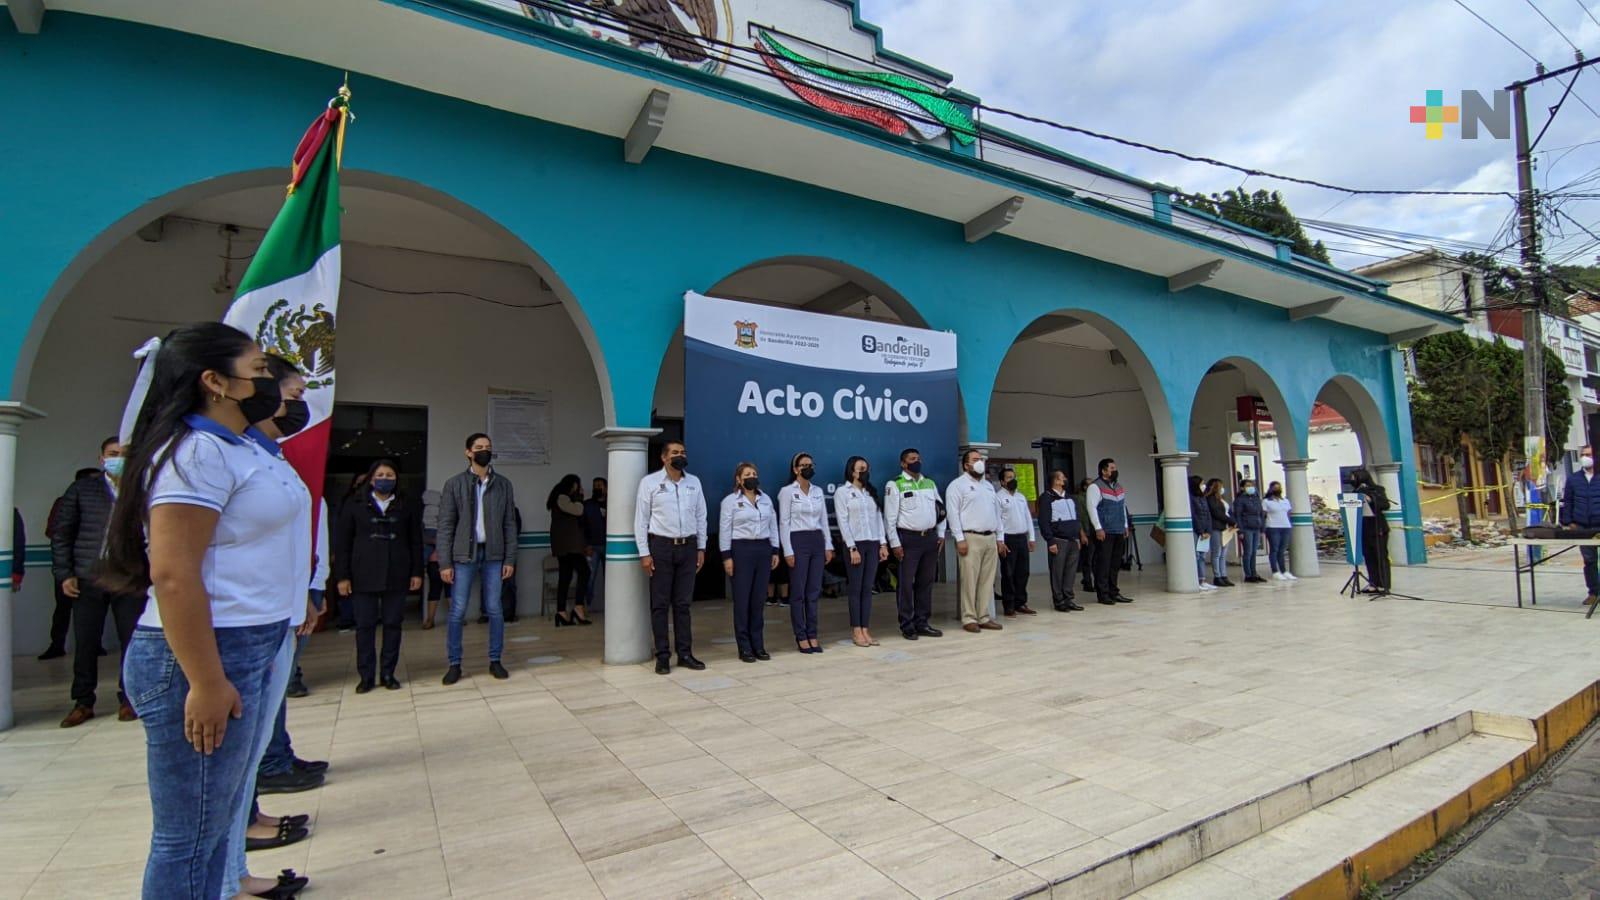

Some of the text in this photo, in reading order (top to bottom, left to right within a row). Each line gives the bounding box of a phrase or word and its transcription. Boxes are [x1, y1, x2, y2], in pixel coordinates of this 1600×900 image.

[768, 337, 793, 345] Banderilla
[862, 335, 930, 357] Banderilla
[738, 381, 928, 424] Acto Cívico
